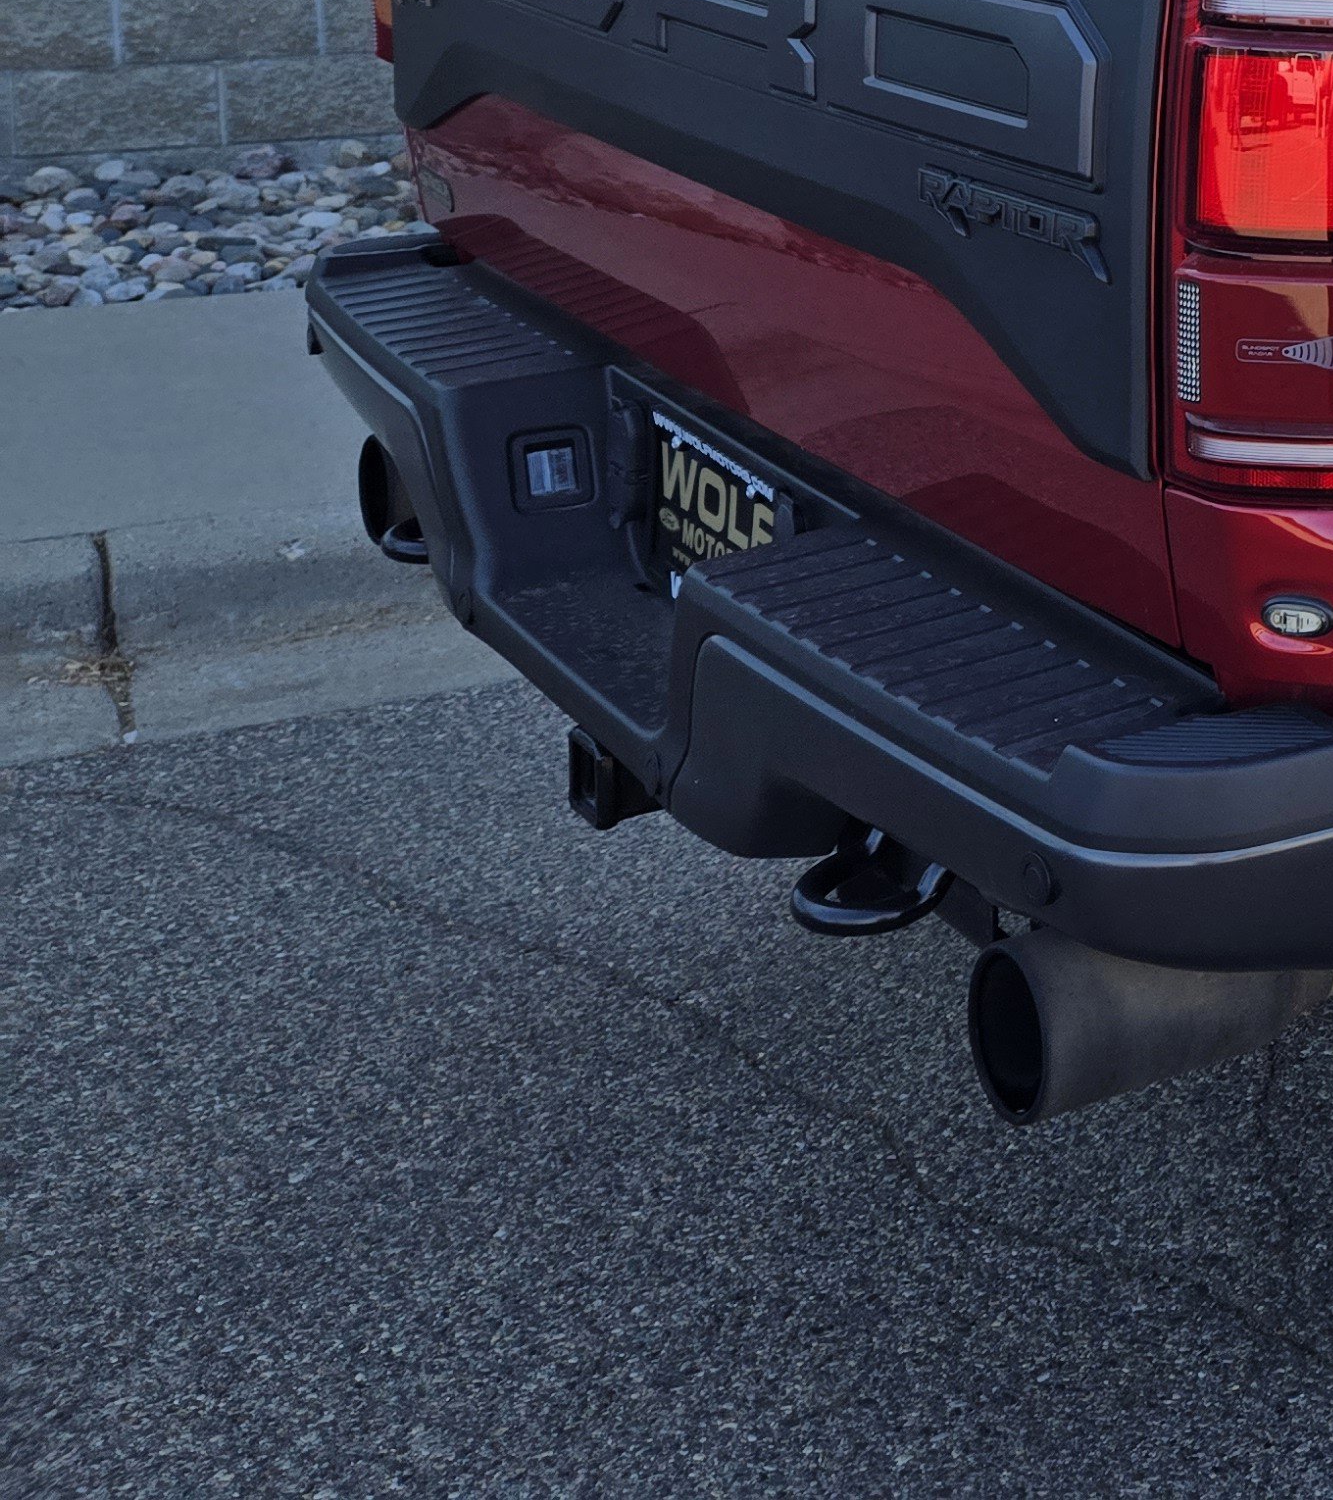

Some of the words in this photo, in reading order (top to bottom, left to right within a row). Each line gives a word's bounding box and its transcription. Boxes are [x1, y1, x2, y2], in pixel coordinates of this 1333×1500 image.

[916, 163, 1111, 286] RAPTOR
[660, 439, 775, 551] WOLF
[681, 517, 734, 561] MOTO
